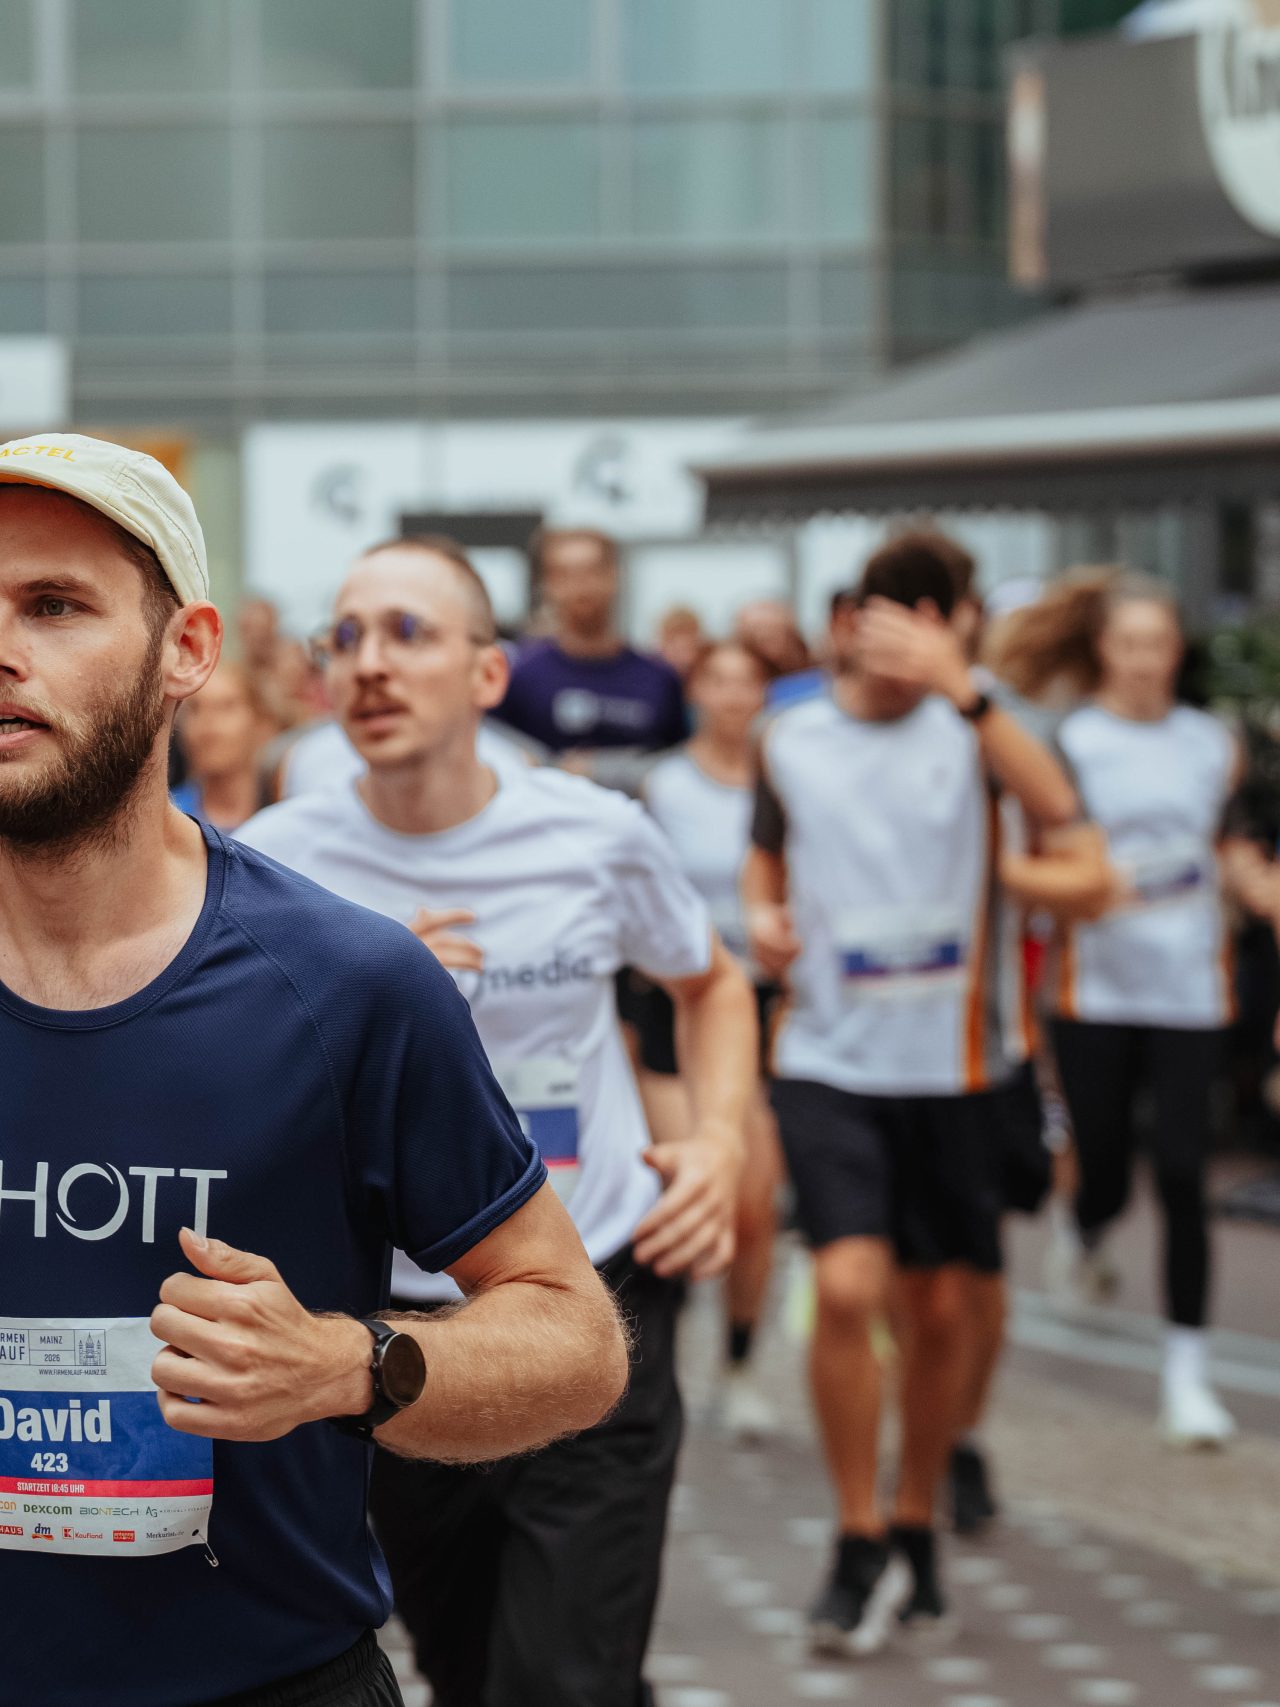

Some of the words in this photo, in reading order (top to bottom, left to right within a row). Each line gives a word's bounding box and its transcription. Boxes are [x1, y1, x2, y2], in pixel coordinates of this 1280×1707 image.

[40, 1335, 63, 1345] MAINZ
[30, 1452, 69, 1473] 423
[16, 1481, 51, 1493] STARTZEIT
[69, 1483, 85, 1494] UHR
[34, 1523, 51, 1535] dm
